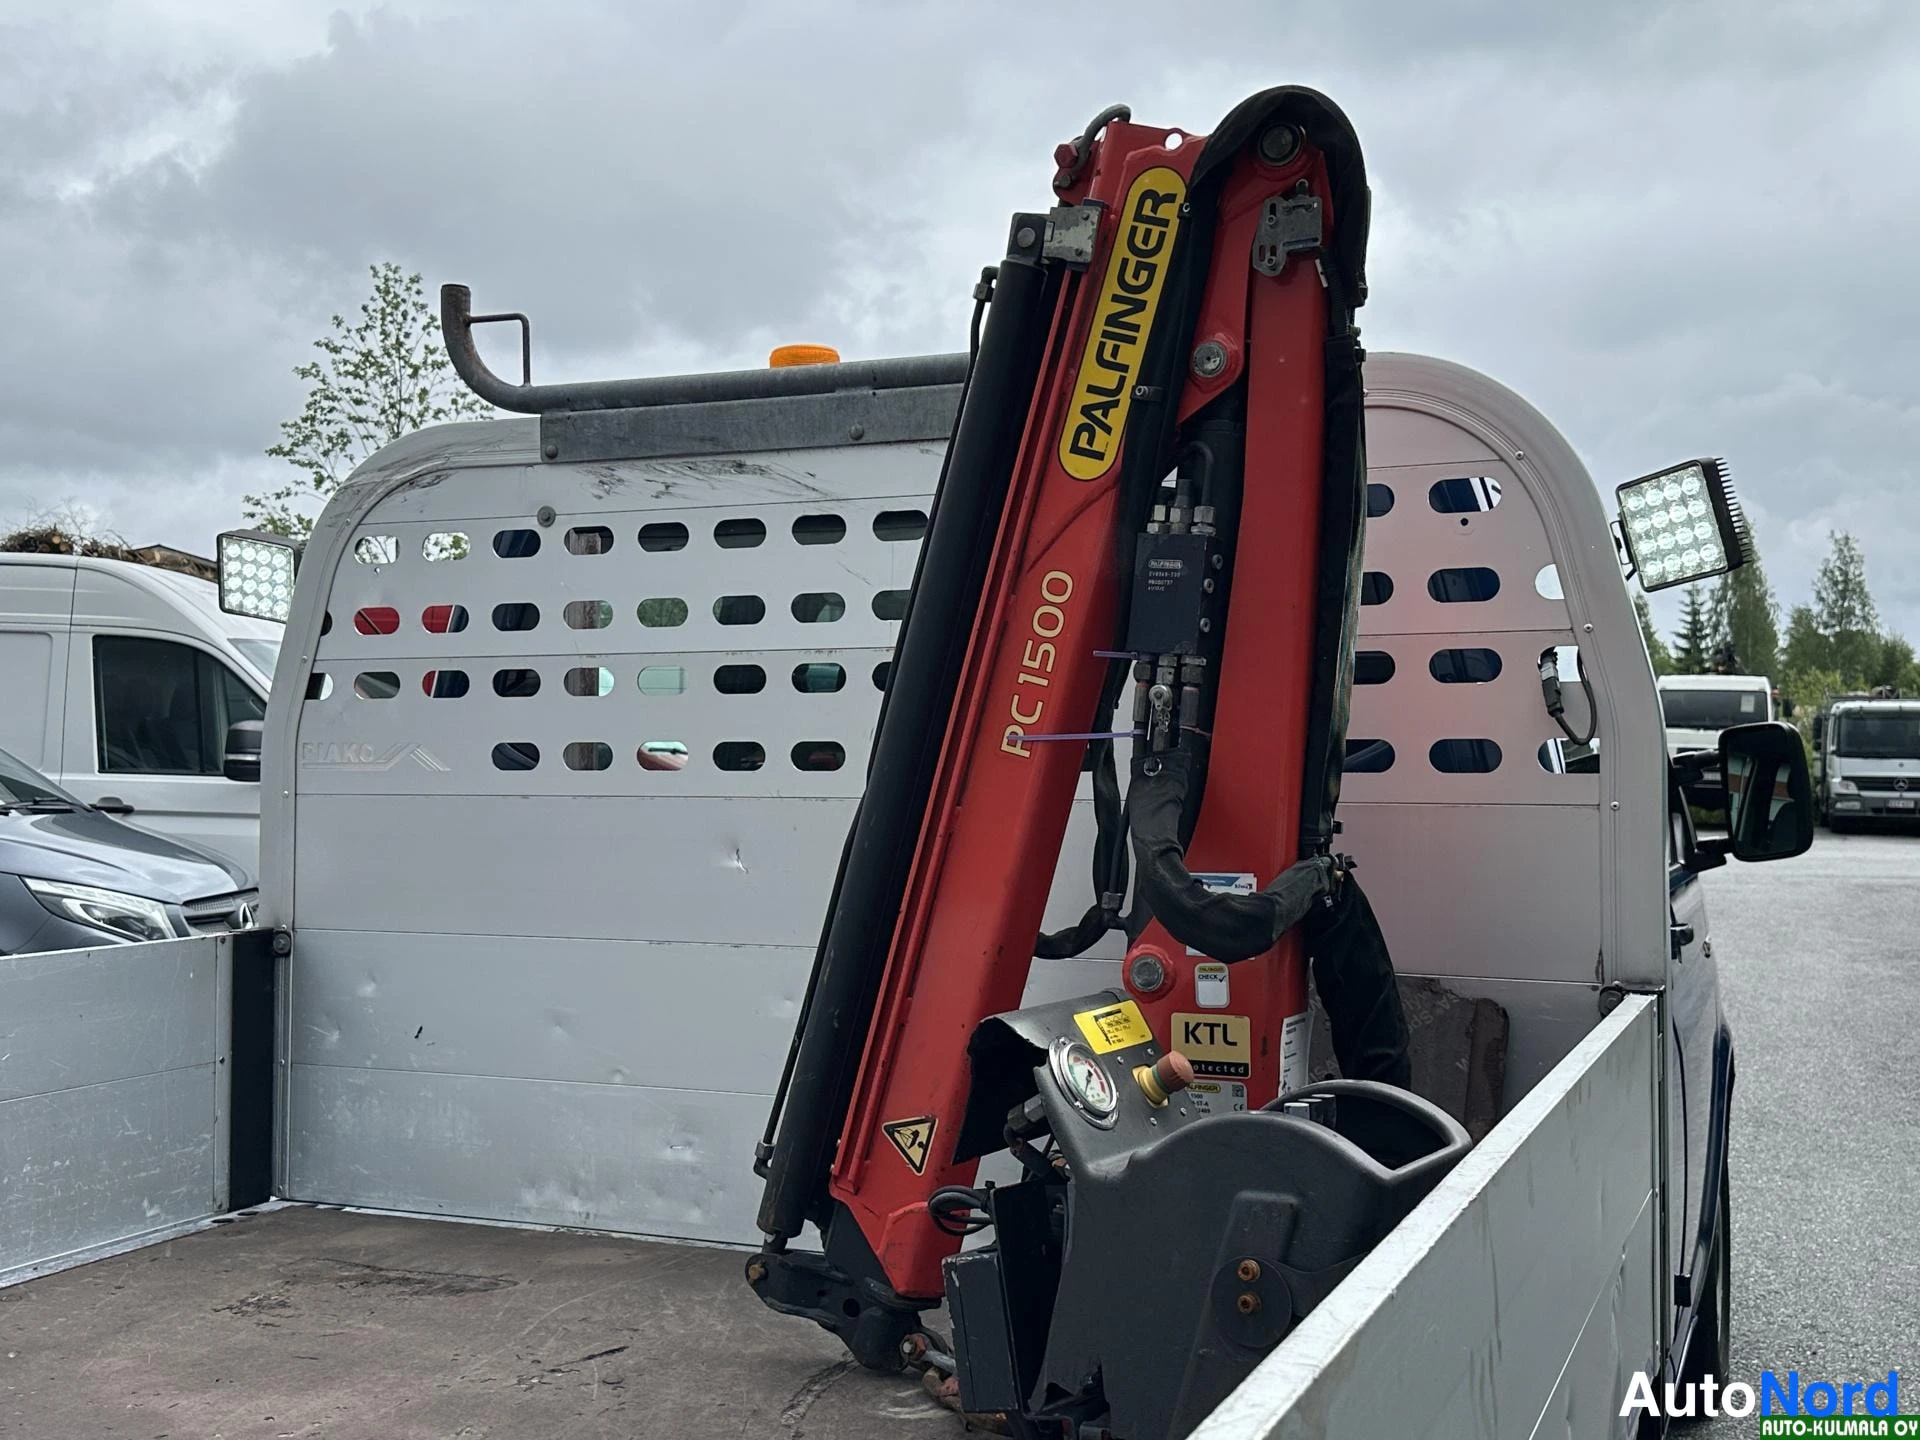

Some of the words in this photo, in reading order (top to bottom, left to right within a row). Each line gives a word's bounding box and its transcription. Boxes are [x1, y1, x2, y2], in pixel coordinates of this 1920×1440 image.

[1069, 189, 1178, 461] PALFINGER
[1017, 570, 1074, 688] 1500
[1000, 694, 1044, 759] PC
[1184, 1021, 1238, 1047] KTL
[1193, 1063, 1244, 1074] otected
